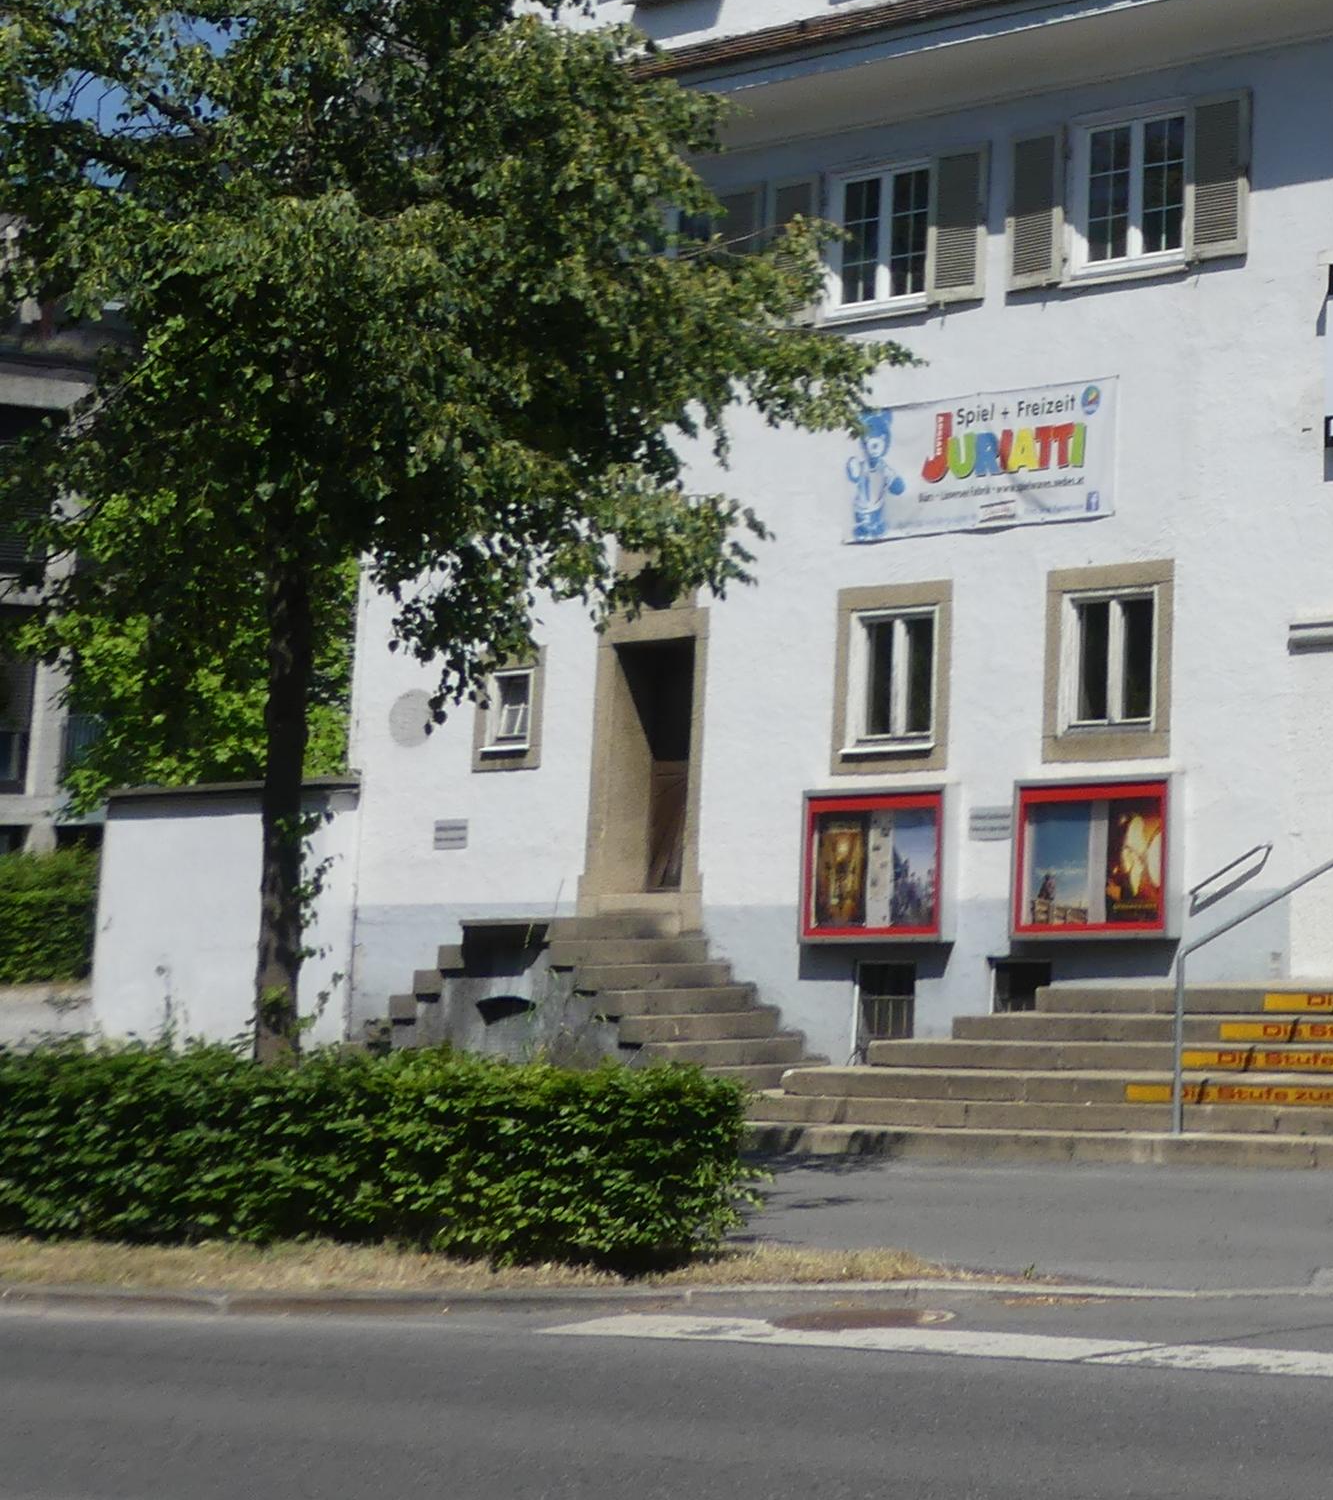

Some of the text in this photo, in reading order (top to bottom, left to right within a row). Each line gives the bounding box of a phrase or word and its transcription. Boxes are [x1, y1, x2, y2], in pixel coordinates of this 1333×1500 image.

[957, 402, 996, 428] Spiel
[1017, 394, 1076, 418] Freizeit
[922, 412, 1087, 484] JURIATTI
[1217, 1086, 1288, 1100] Stufe
